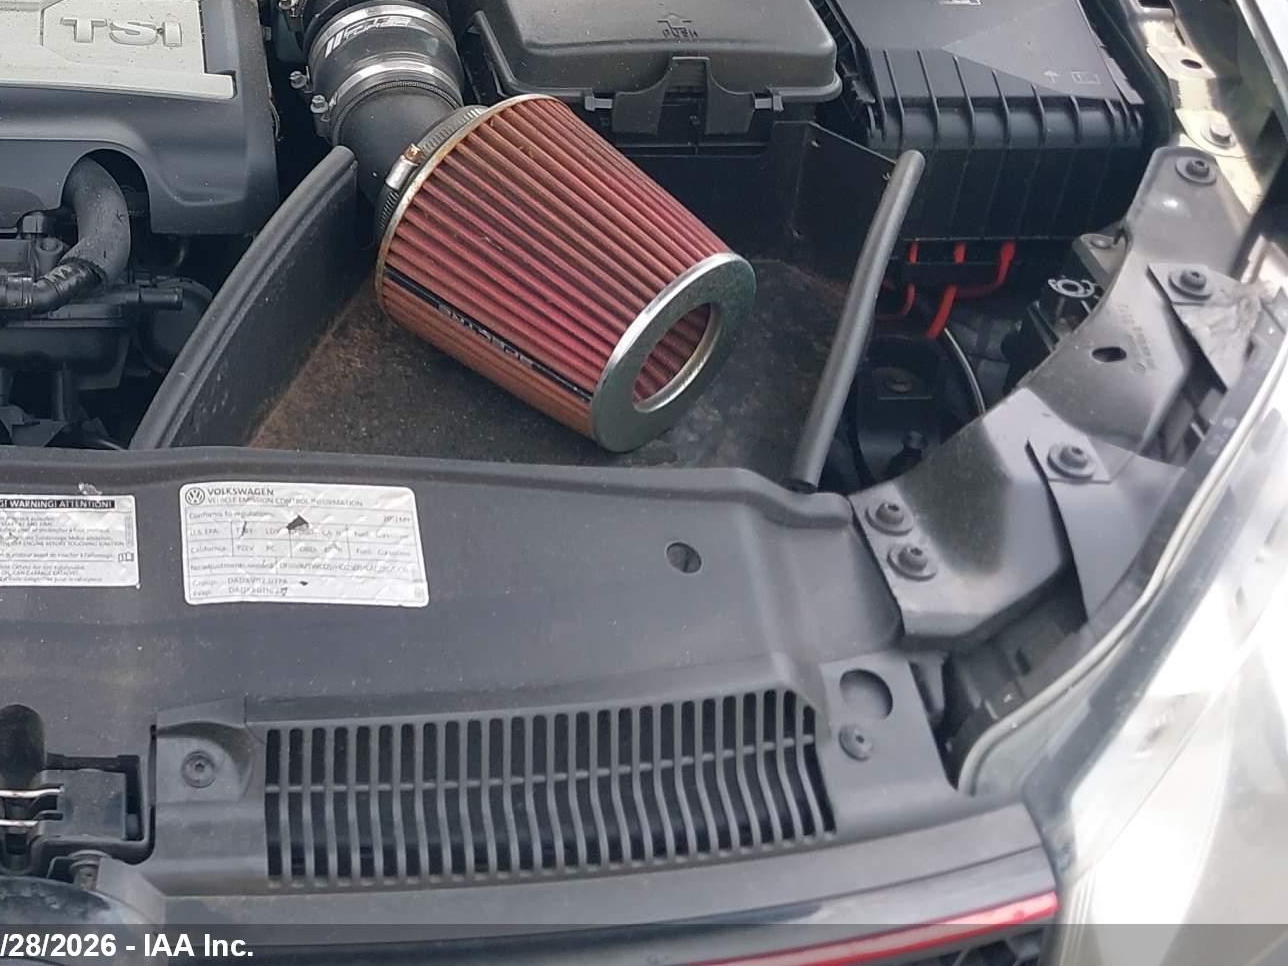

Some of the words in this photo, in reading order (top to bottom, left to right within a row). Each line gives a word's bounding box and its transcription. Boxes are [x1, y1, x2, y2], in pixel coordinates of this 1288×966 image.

[60, 17, 182, 47] TSI
[207, 488, 274, 496] VOLKSWAGEN
[10, 500, 57, 508] WARNING!
[59, 500, 112, 508] ATTENTION!
